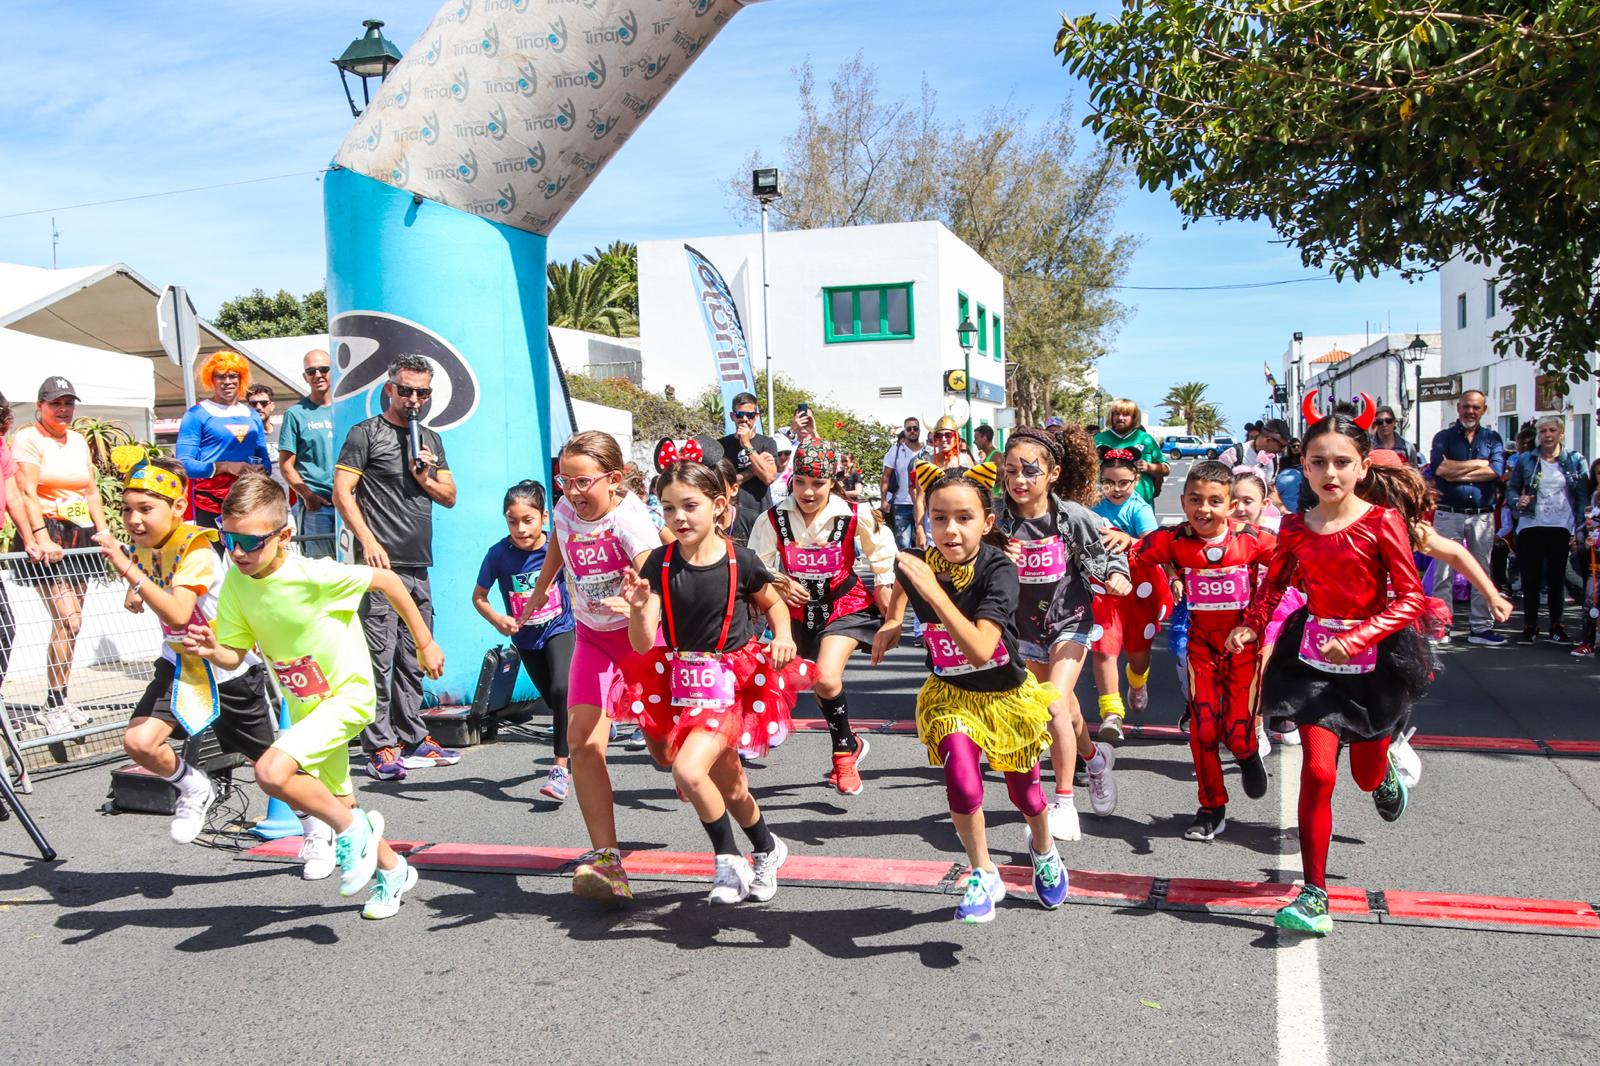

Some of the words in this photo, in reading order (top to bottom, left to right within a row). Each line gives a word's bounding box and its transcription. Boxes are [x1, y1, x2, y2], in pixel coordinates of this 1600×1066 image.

[576, 546, 608, 566] 324
[797, 553, 828, 566] 314
[1197, 580, 1235, 596] 399
[680, 668, 716, 688] 316
